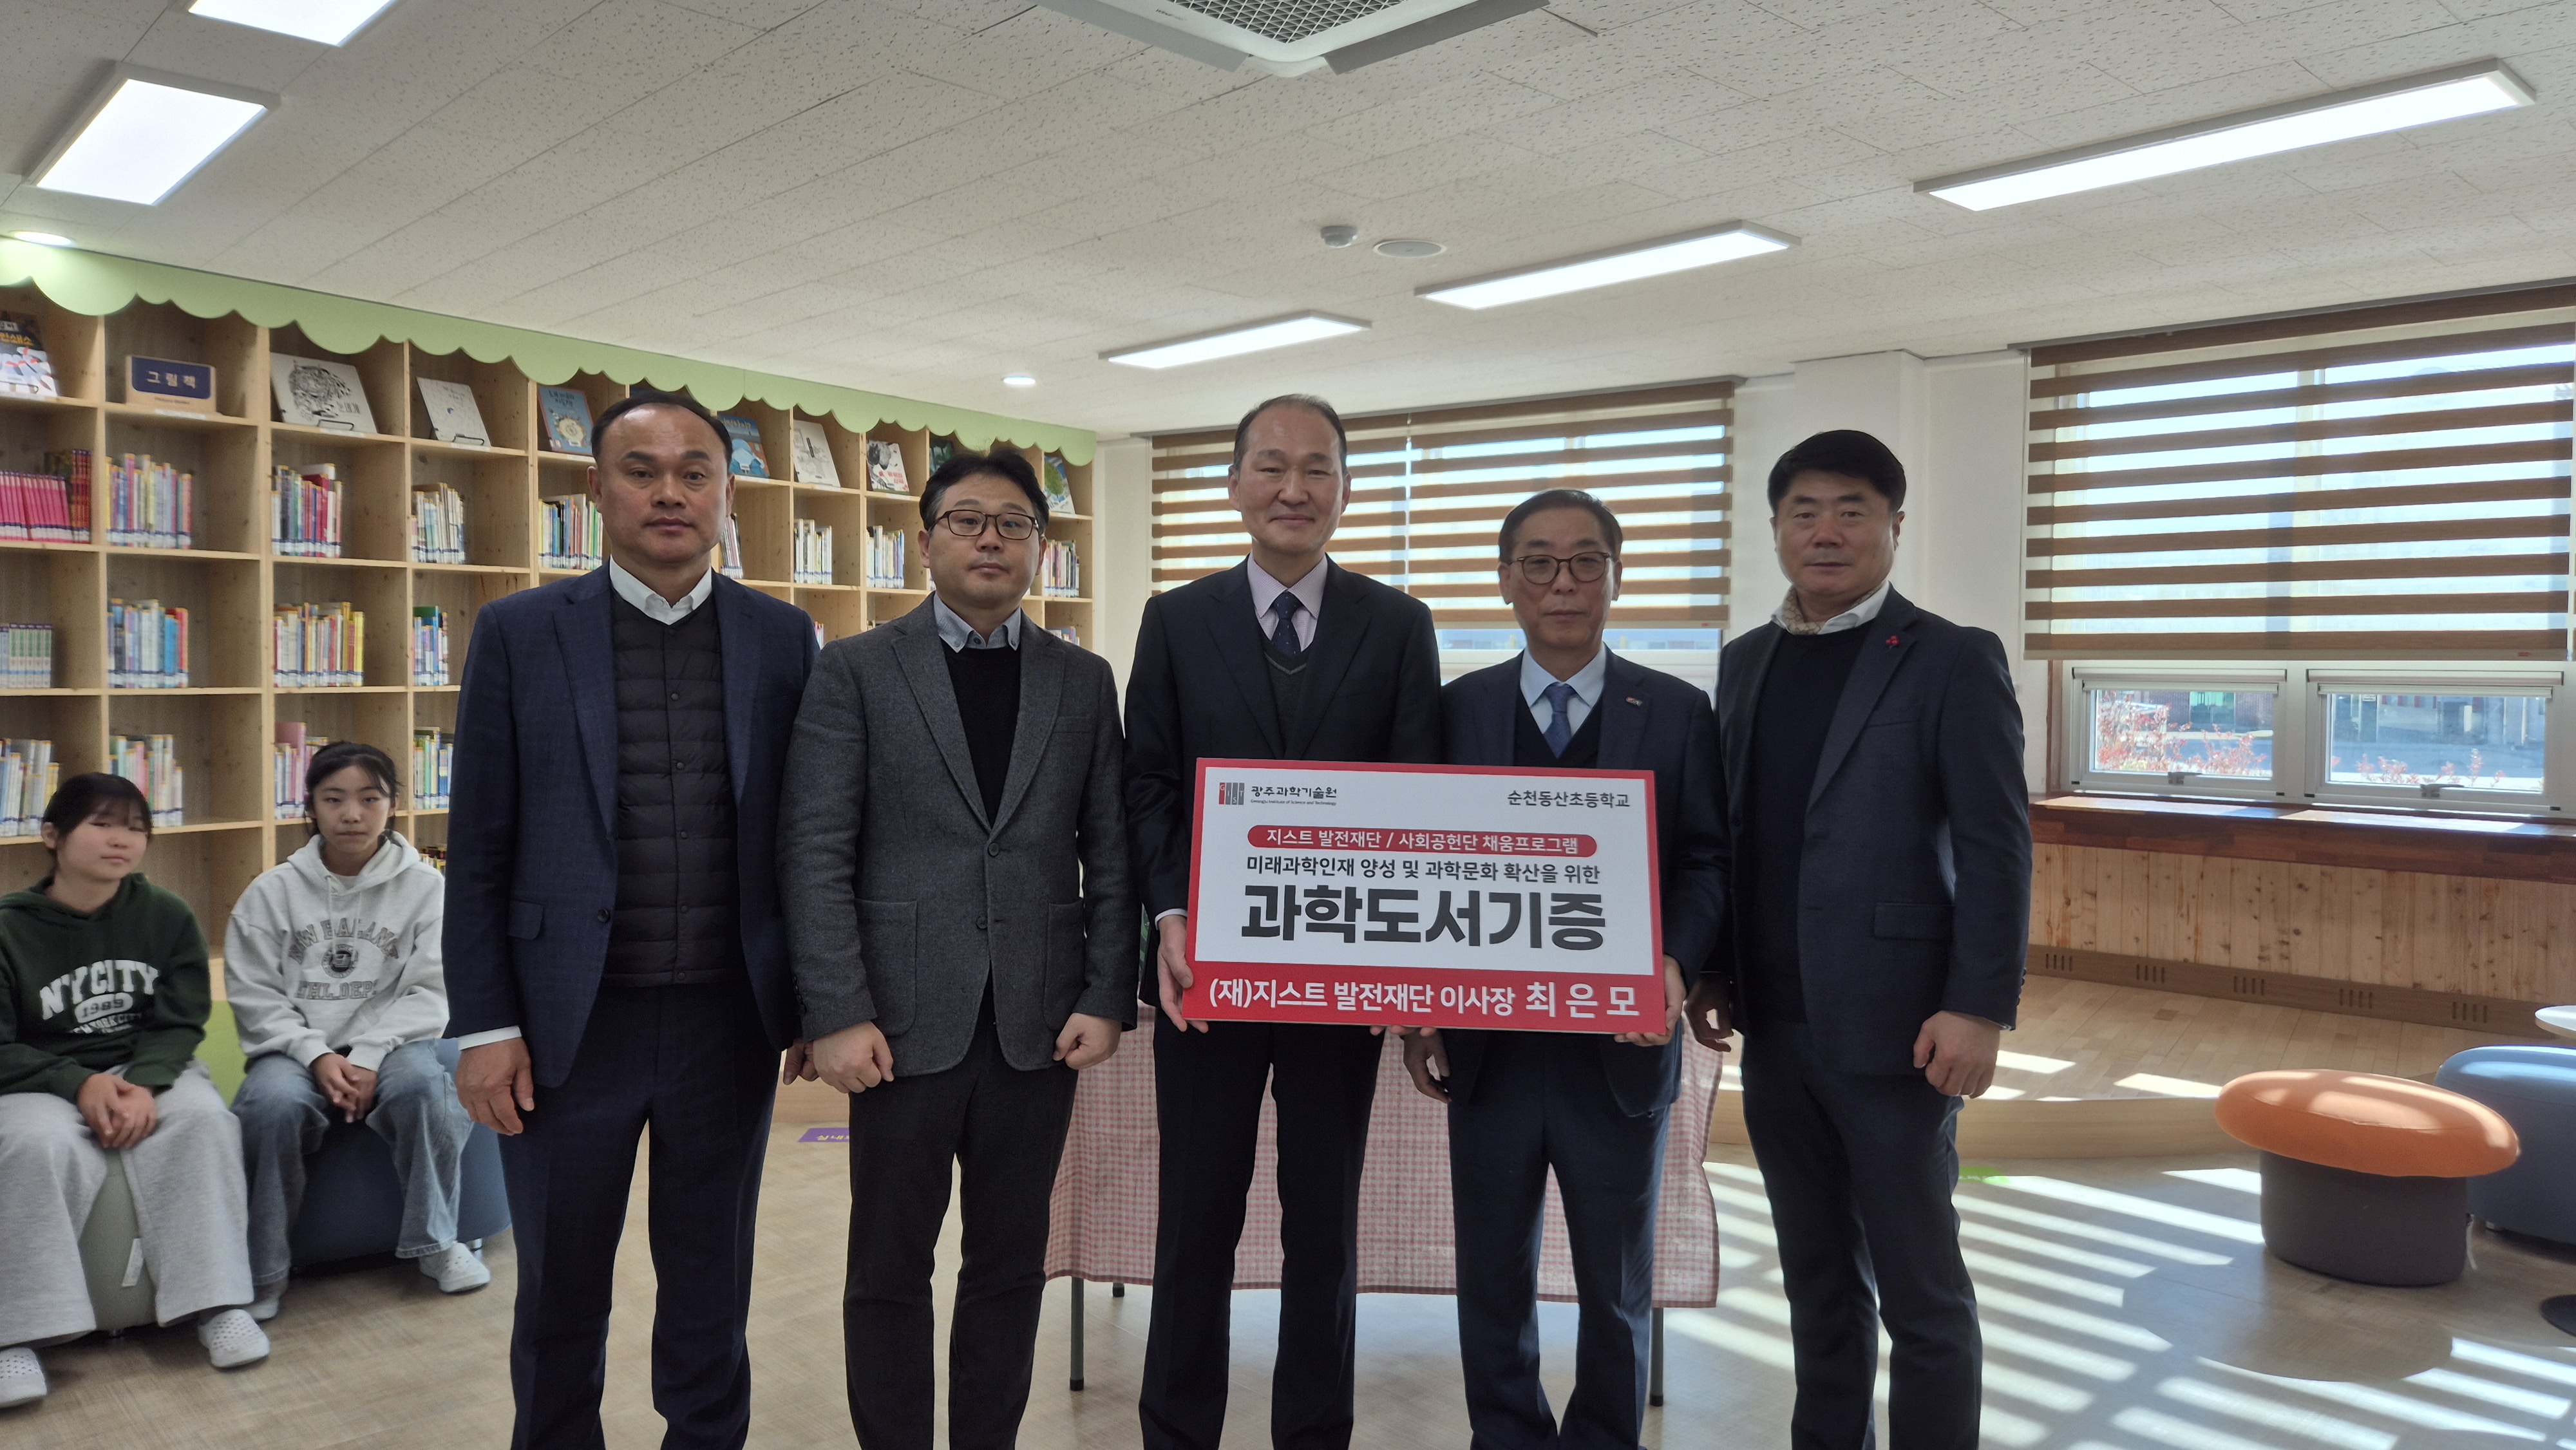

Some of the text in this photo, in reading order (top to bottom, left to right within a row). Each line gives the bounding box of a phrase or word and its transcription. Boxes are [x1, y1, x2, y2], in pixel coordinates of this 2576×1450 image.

[1251, 786, 1336, 799] 광주과학기술원
[1507, 790, 1631, 809] 순천동산초등학교
[1266, 828, 1314, 845] 지스트
[1318, 830, 1382, 849] 발전재단
[1398, 833, 1479, 851] 사회공헌단
[1482, 834, 1578, 855] 채움프로그램
[1247, 855, 1600, 885] 미래과학인재 양성 및 과학문화 확산을 위한
[1241, 884, 1606, 951] 과학도서기증
[81, 999, 124, 1018] 1989
[1209, 978, 1328, 1008] (재)지스트
[1334, 981, 1435, 1013] 발전재단
[1440, 984, 1516, 1017] 이사장
